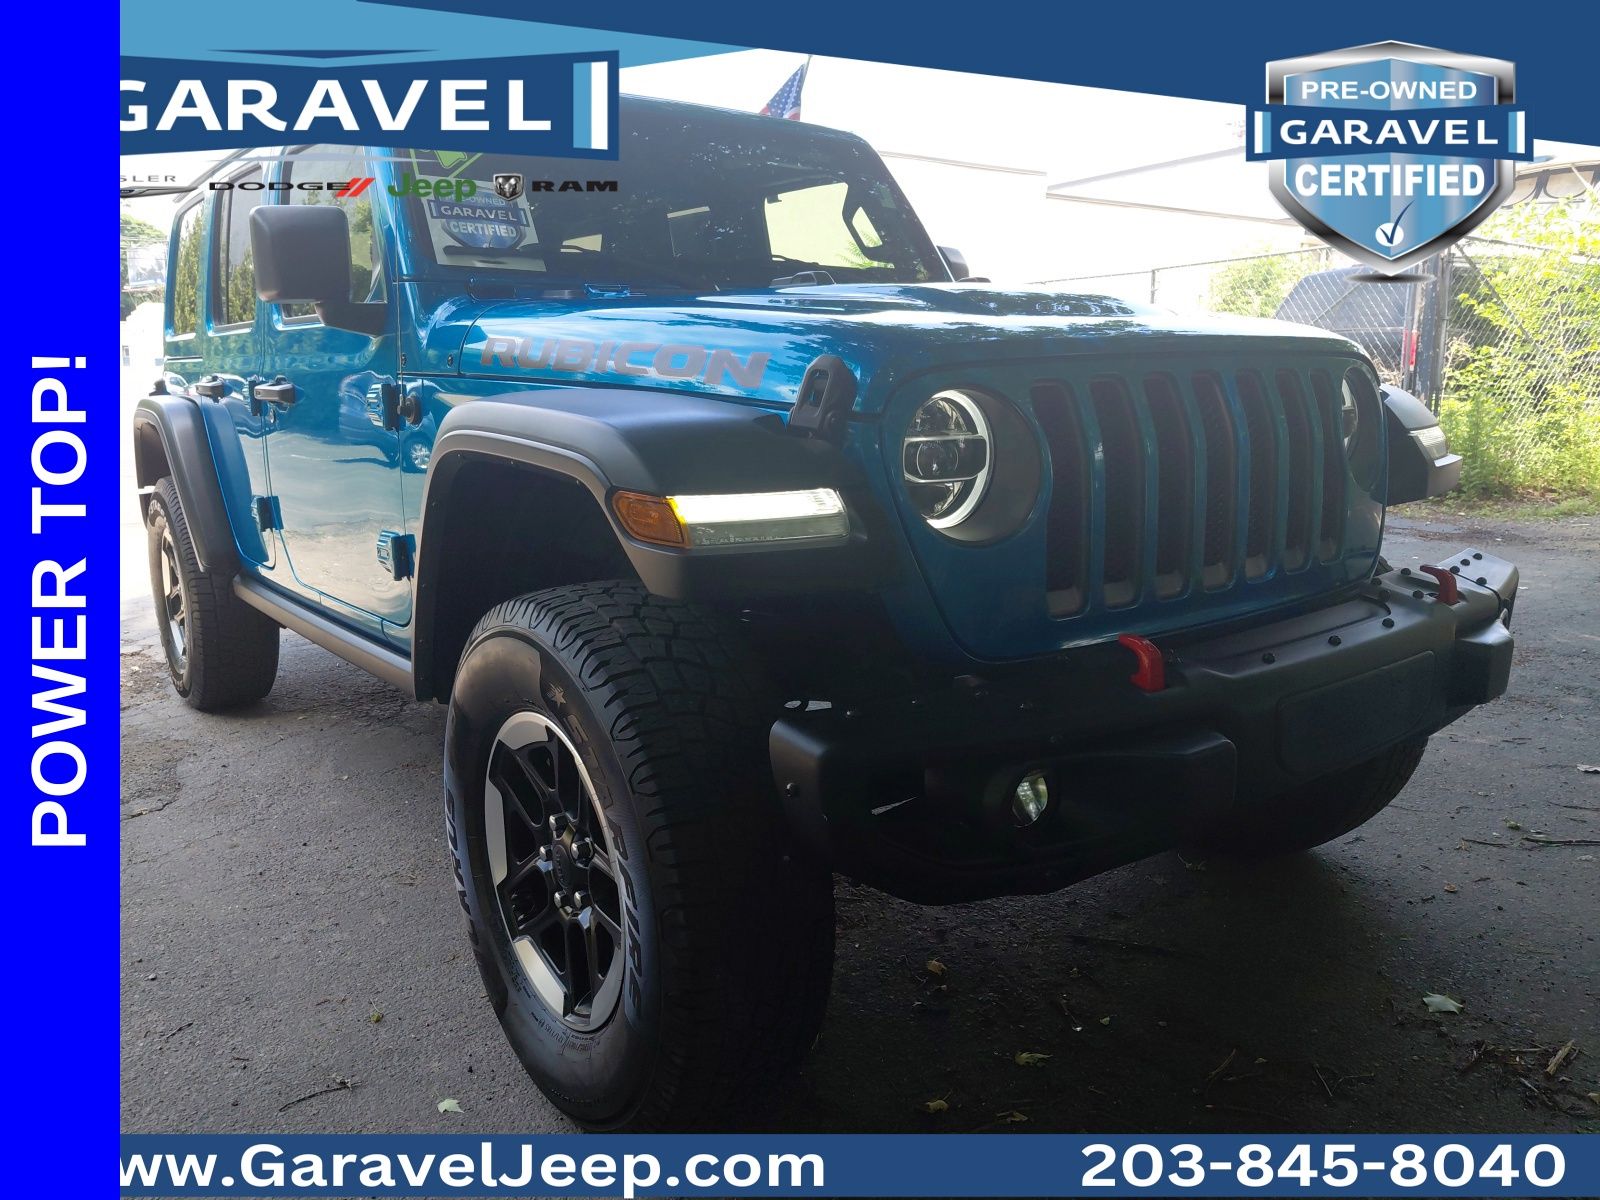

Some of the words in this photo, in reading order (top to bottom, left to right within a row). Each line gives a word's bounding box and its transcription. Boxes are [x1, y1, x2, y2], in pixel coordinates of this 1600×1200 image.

[441, 205, 518, 221] GARAVEL
[450, 221, 517, 238] CERTIFIED
[480, 337, 772, 388] RUBICON
